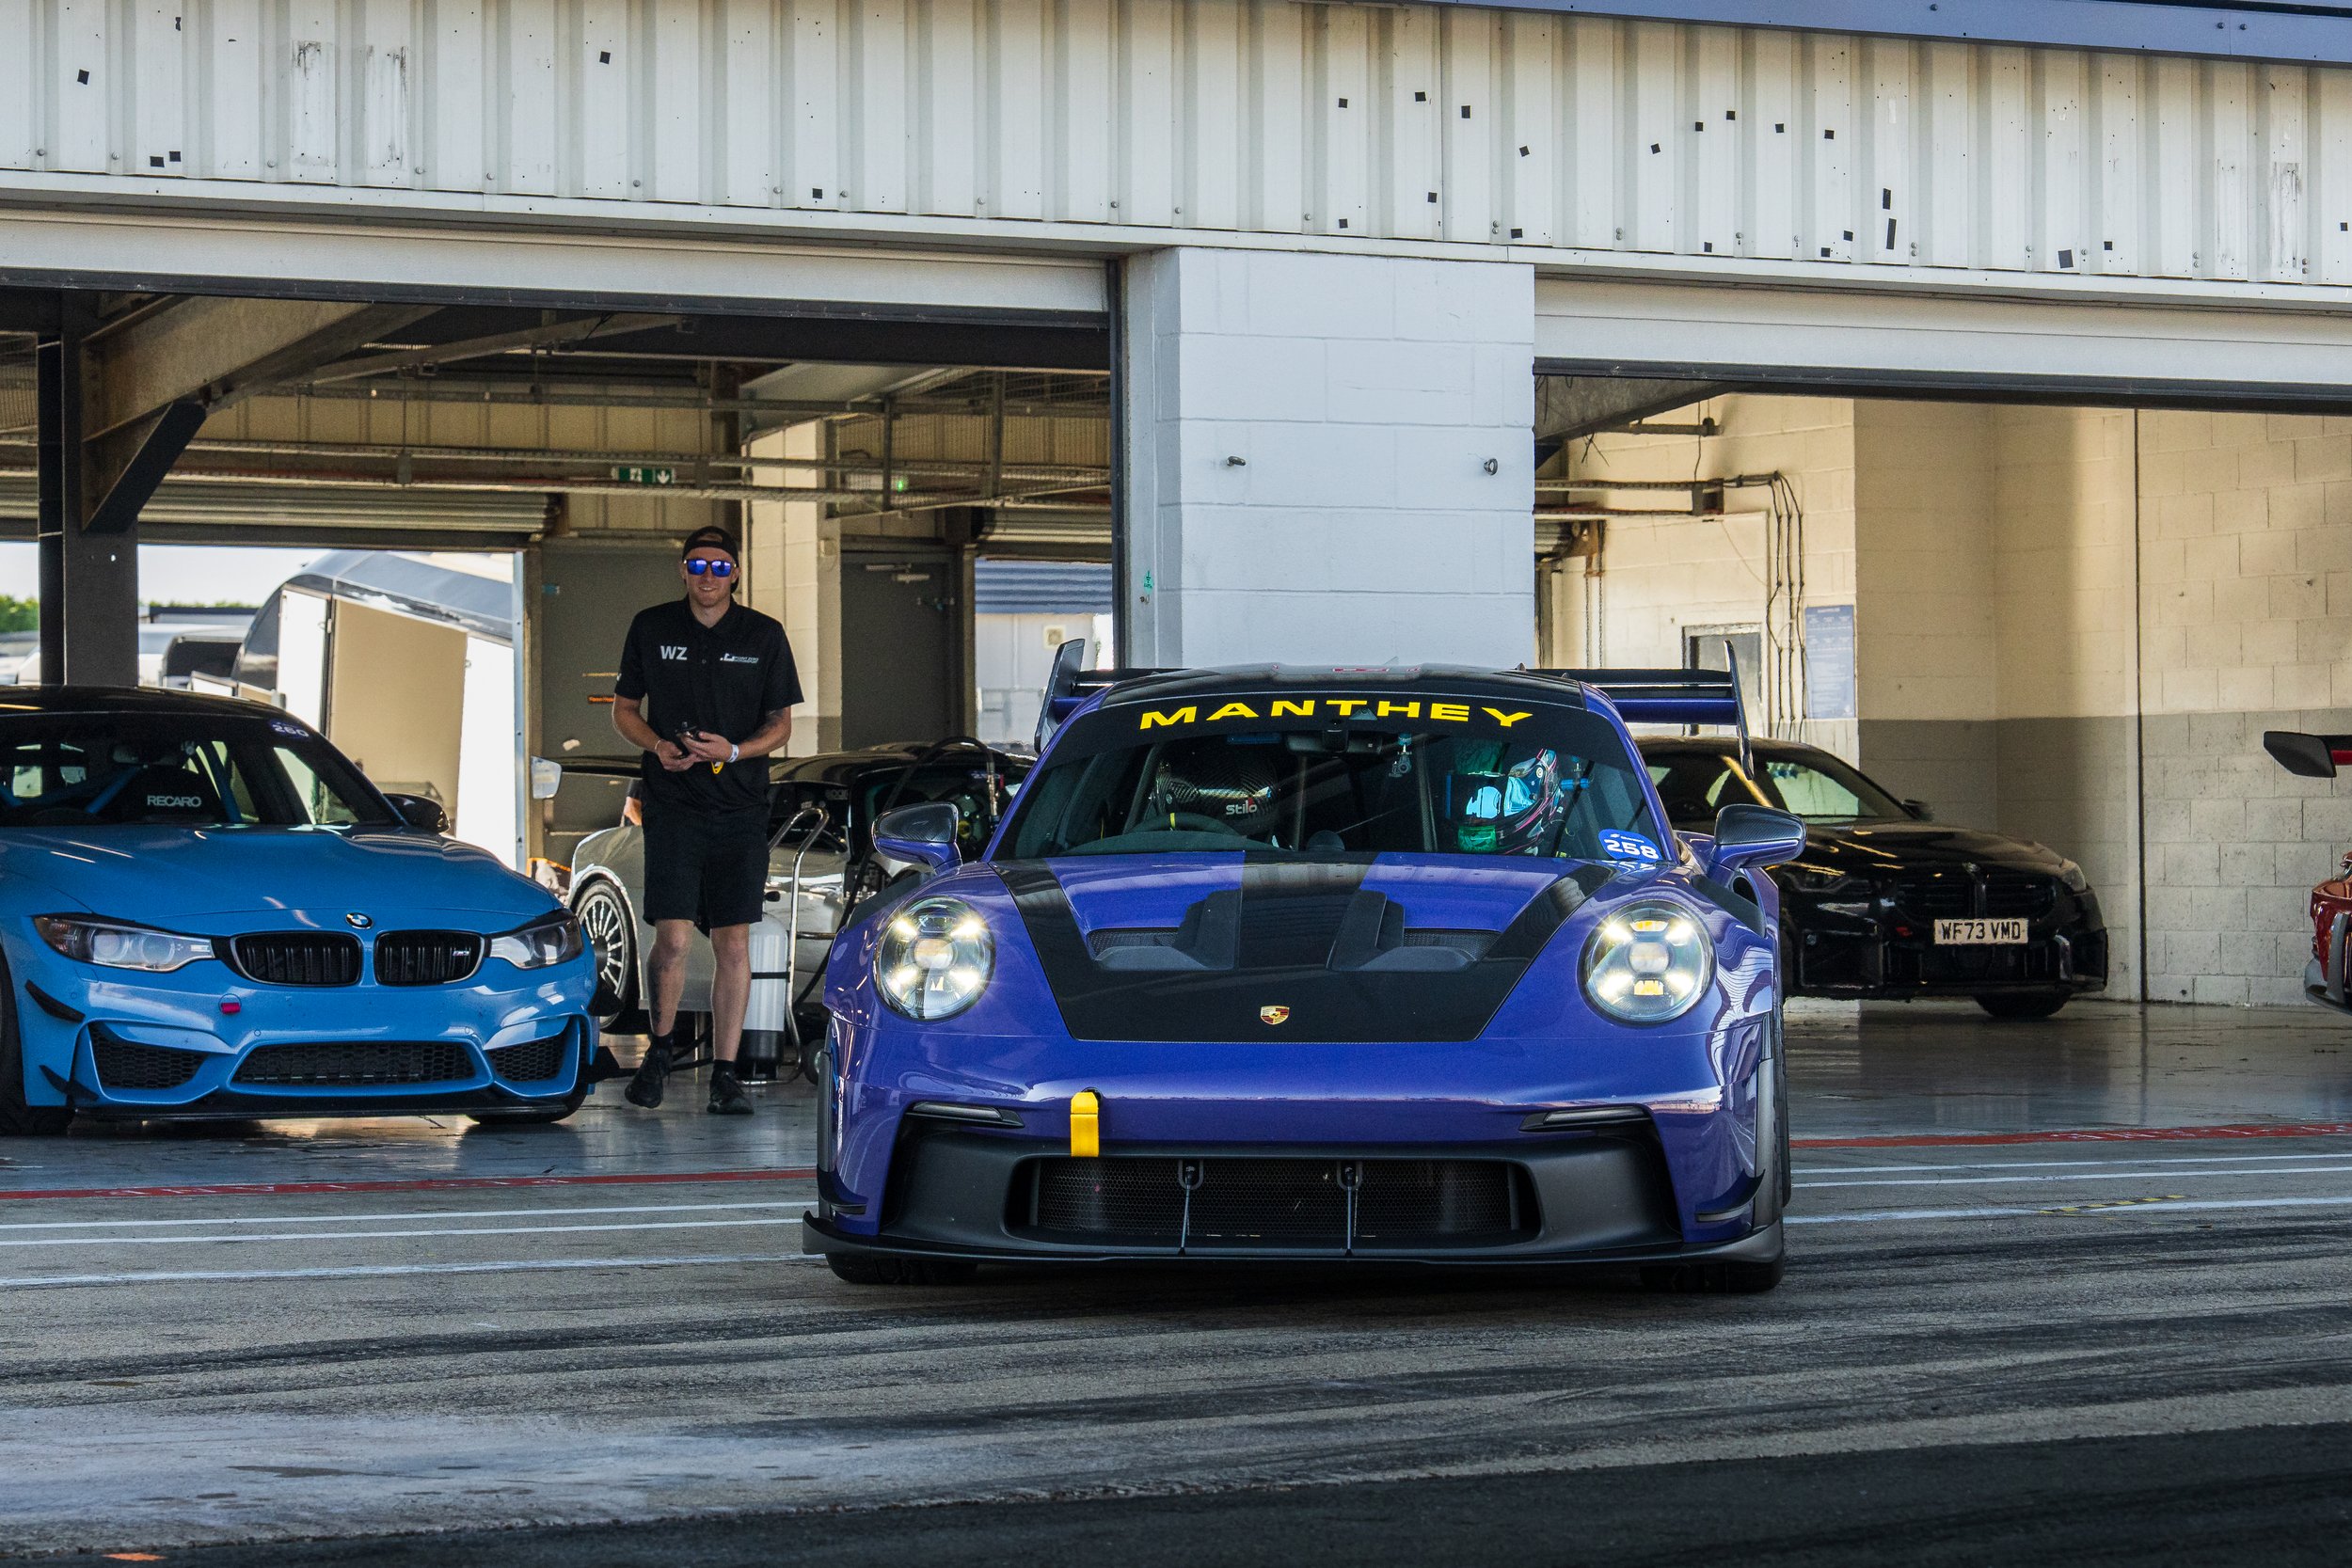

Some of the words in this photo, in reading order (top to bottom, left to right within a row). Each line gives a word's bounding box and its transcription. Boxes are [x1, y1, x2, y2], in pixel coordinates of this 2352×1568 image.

[660, 645, 688, 660] WZ
[1140, 700, 1534, 730] MANTHEY
[147, 795, 202, 807] RECARO
[1603, 839, 1660, 860] 258
[1941, 922, 1985, 940] WF73
[1991, 922, 2021, 940] VMD
